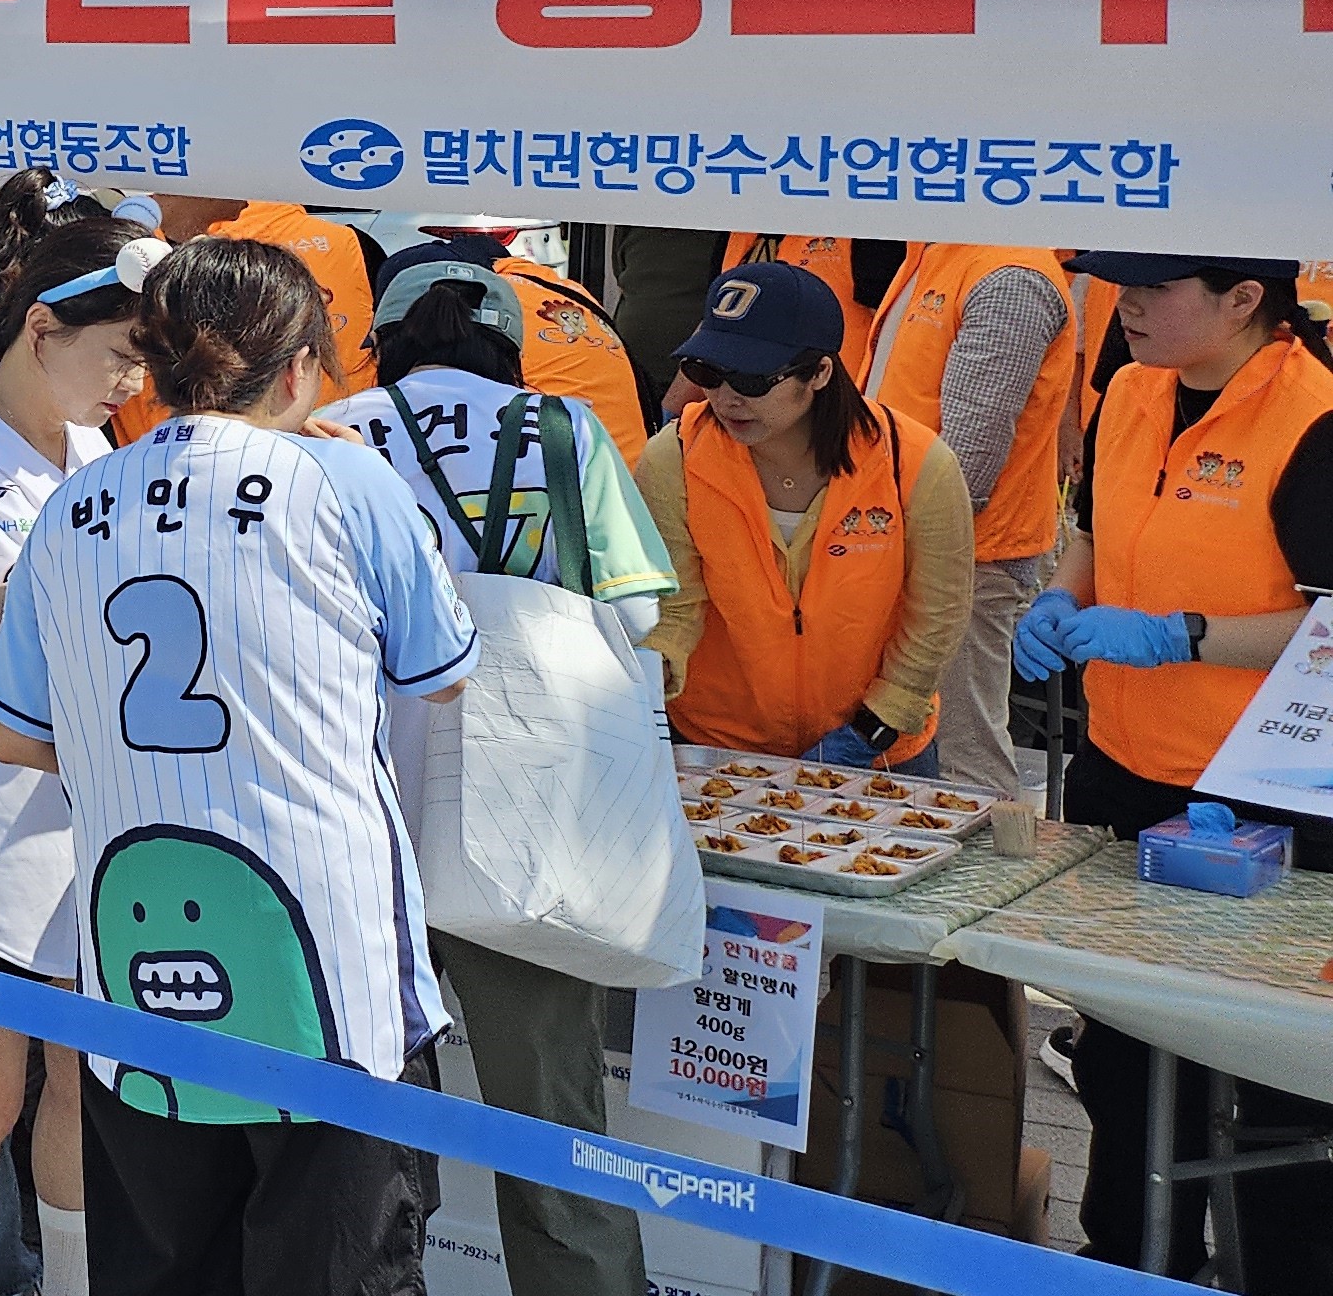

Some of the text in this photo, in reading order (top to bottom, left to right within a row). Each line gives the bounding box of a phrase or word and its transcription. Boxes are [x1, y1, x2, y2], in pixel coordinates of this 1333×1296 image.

[422, 129, 1180, 210] 멸치권현망수산업협동조합
[71, 474, 273, 541] 박민우
[104, 573, 231, 754] 2
[1257, 720, 1324, 743] 준비중
[723, 939, 798, 972] 인기상품
[722, 966, 798, 999] 할인행사
[695, 1014, 746, 1042] 400g
[670, 1036, 769, 1078] 12,000원
[668, 1058, 769, 1100] 10,000원
[571, 1137, 643, 1187] CHANGWON
[681, 1172, 756, 1213] PARK
[438, 1237, 501, 1265] 641-2923-4
